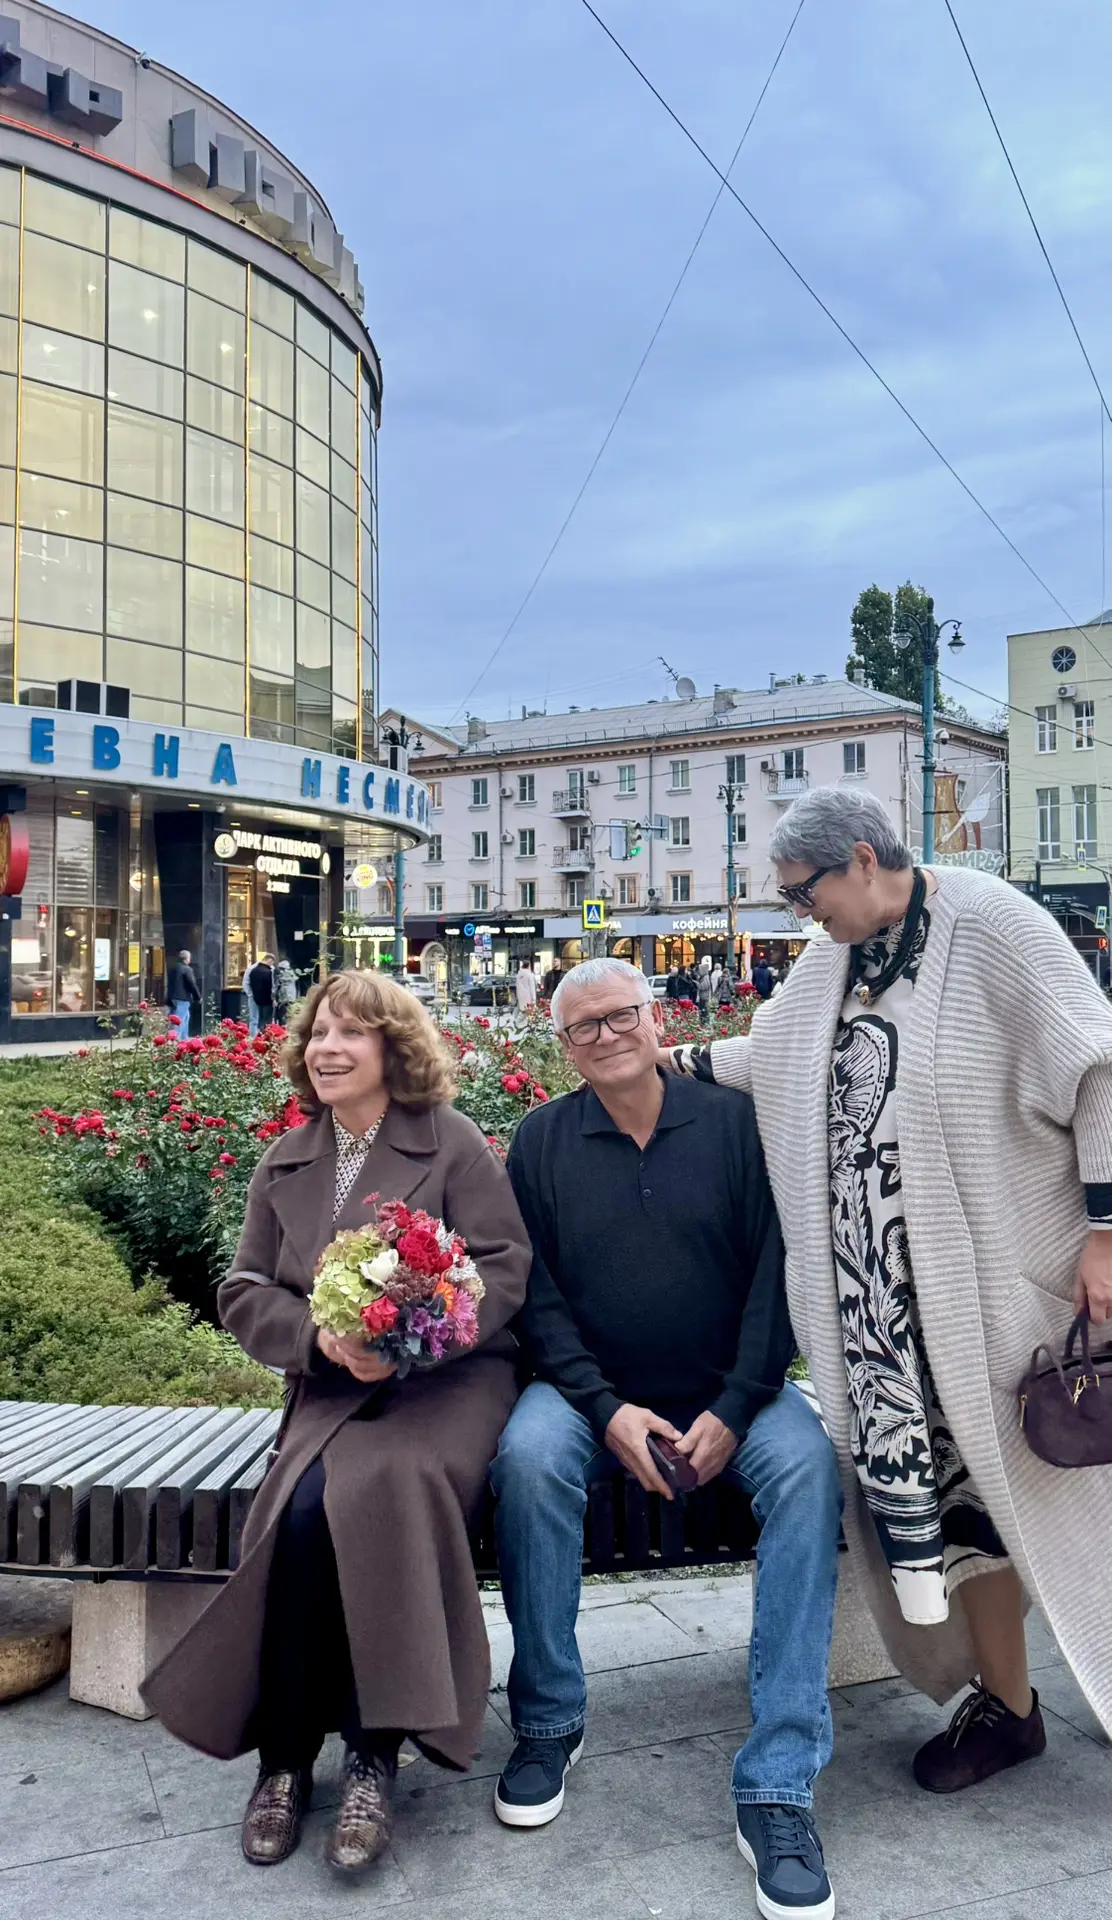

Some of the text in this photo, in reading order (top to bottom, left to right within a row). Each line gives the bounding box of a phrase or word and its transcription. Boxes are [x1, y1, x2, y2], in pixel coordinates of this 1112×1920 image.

[302, 757, 429, 828] НЕСМЕЯ
[233, 829, 321, 859] ПАРК АКТИВНОГО
[256, 855, 300, 877] ОТДЫХА
[672, 916, 728, 931] кофейня
